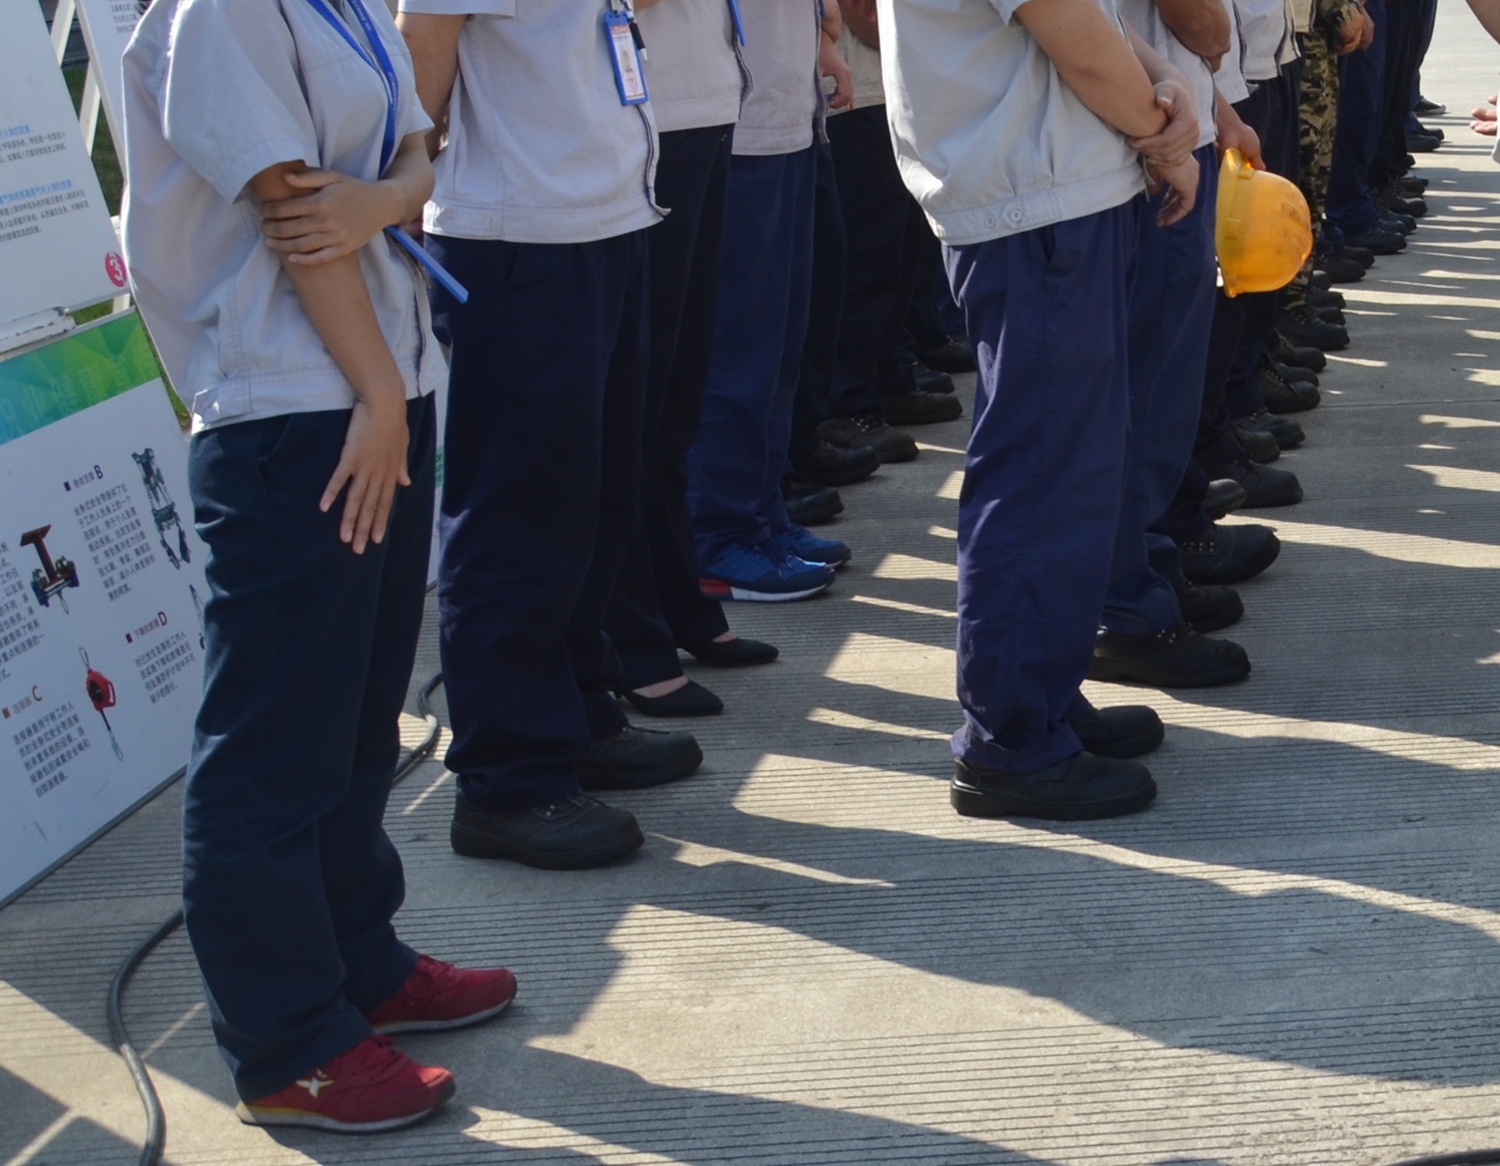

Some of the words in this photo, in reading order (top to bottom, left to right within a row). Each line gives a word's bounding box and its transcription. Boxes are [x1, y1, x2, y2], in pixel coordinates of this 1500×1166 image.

[94, 464, 104, 479] B
[157, 611, 167, 626] D
[32, 685, 42, 702] C
